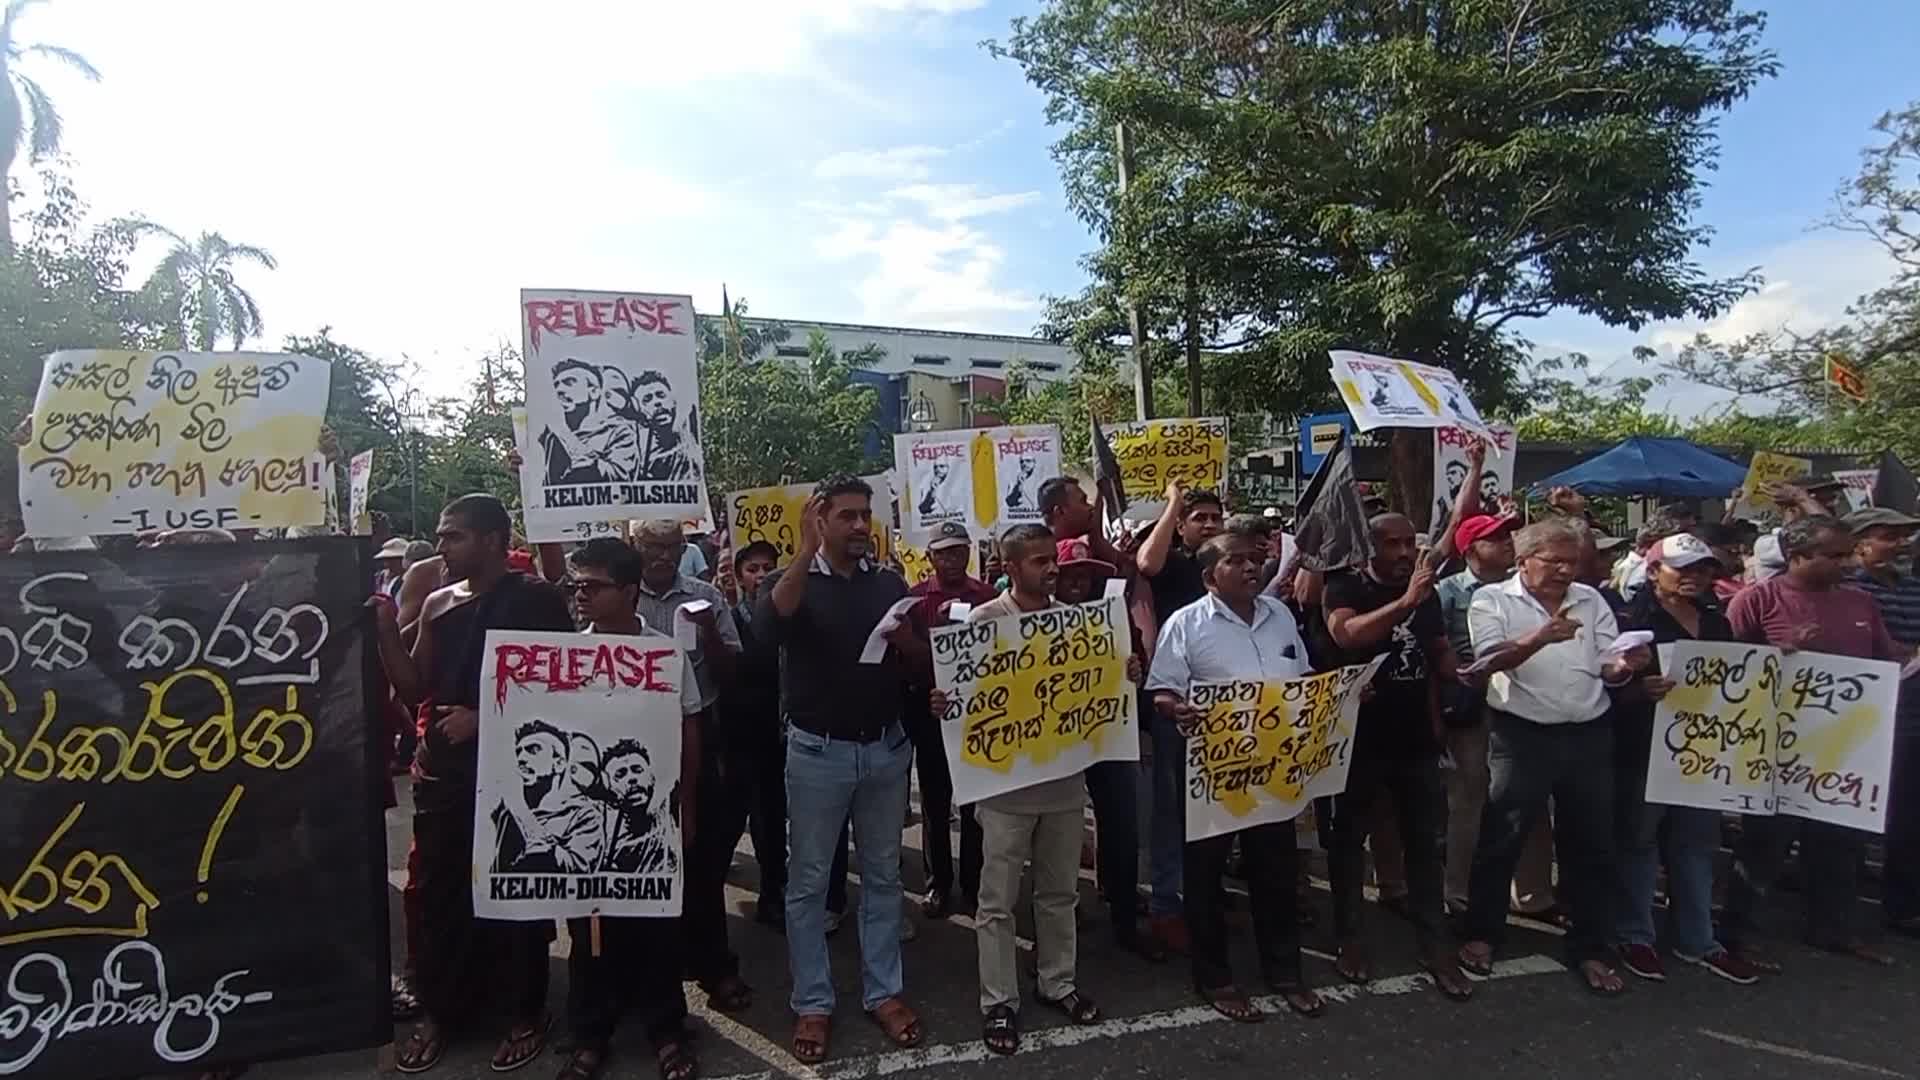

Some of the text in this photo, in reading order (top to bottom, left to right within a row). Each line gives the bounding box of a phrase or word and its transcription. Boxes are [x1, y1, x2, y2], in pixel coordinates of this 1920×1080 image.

[524, 298, 688, 350] RELEASE
[544, 484, 699, 509] KELUM-DILSHAN
[493, 644, 680, 708] RELEASE
[489, 875, 673, 902] KELUM-DILSHAN
